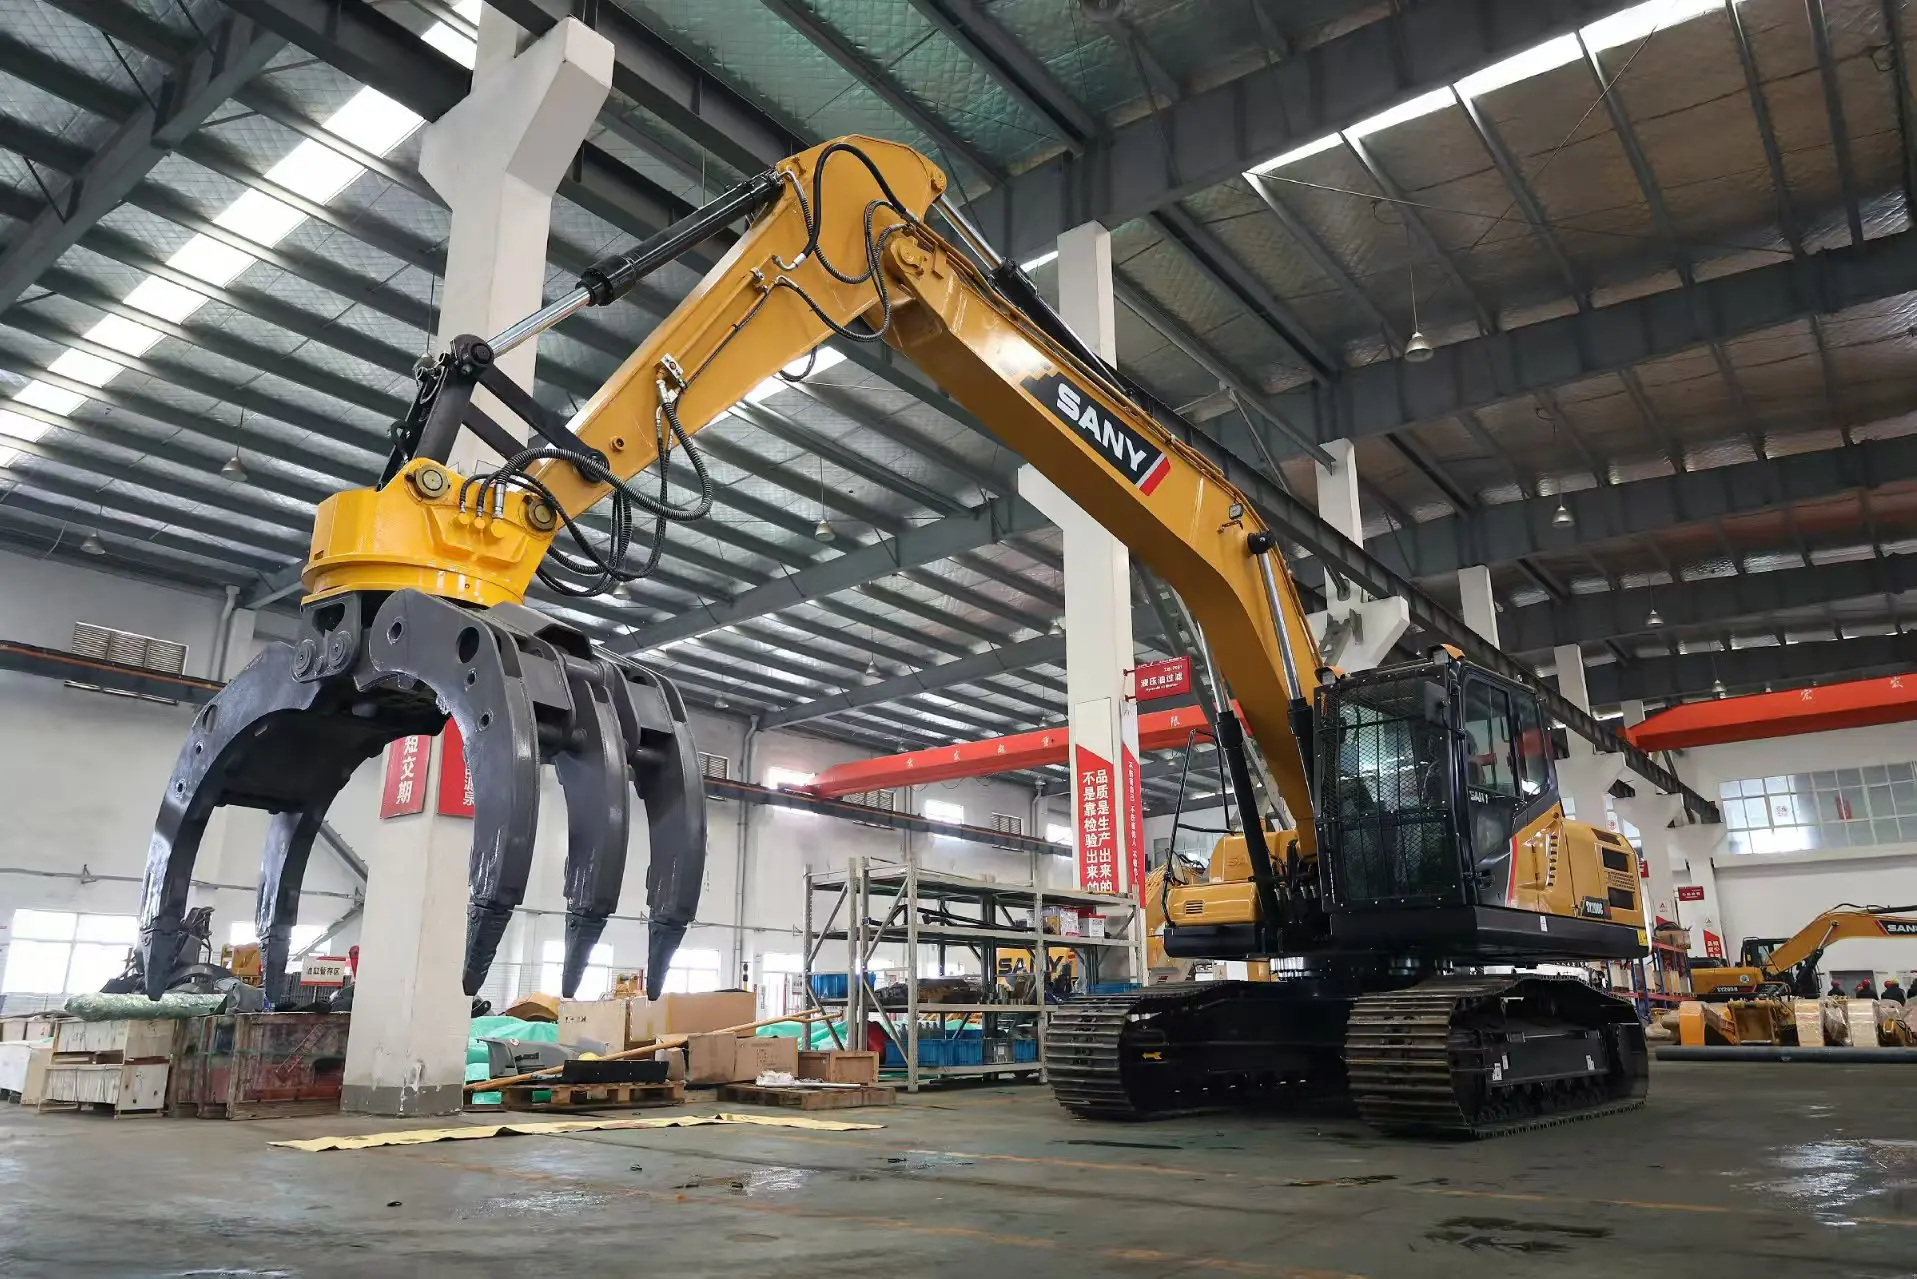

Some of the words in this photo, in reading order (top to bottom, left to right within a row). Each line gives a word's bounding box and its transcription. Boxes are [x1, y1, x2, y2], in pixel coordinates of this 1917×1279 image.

[1056, 382, 1148, 472] SANY
[1095, 769, 1113, 892] 品质是生产出来的
[1887, 924, 1917, 933] SAN
